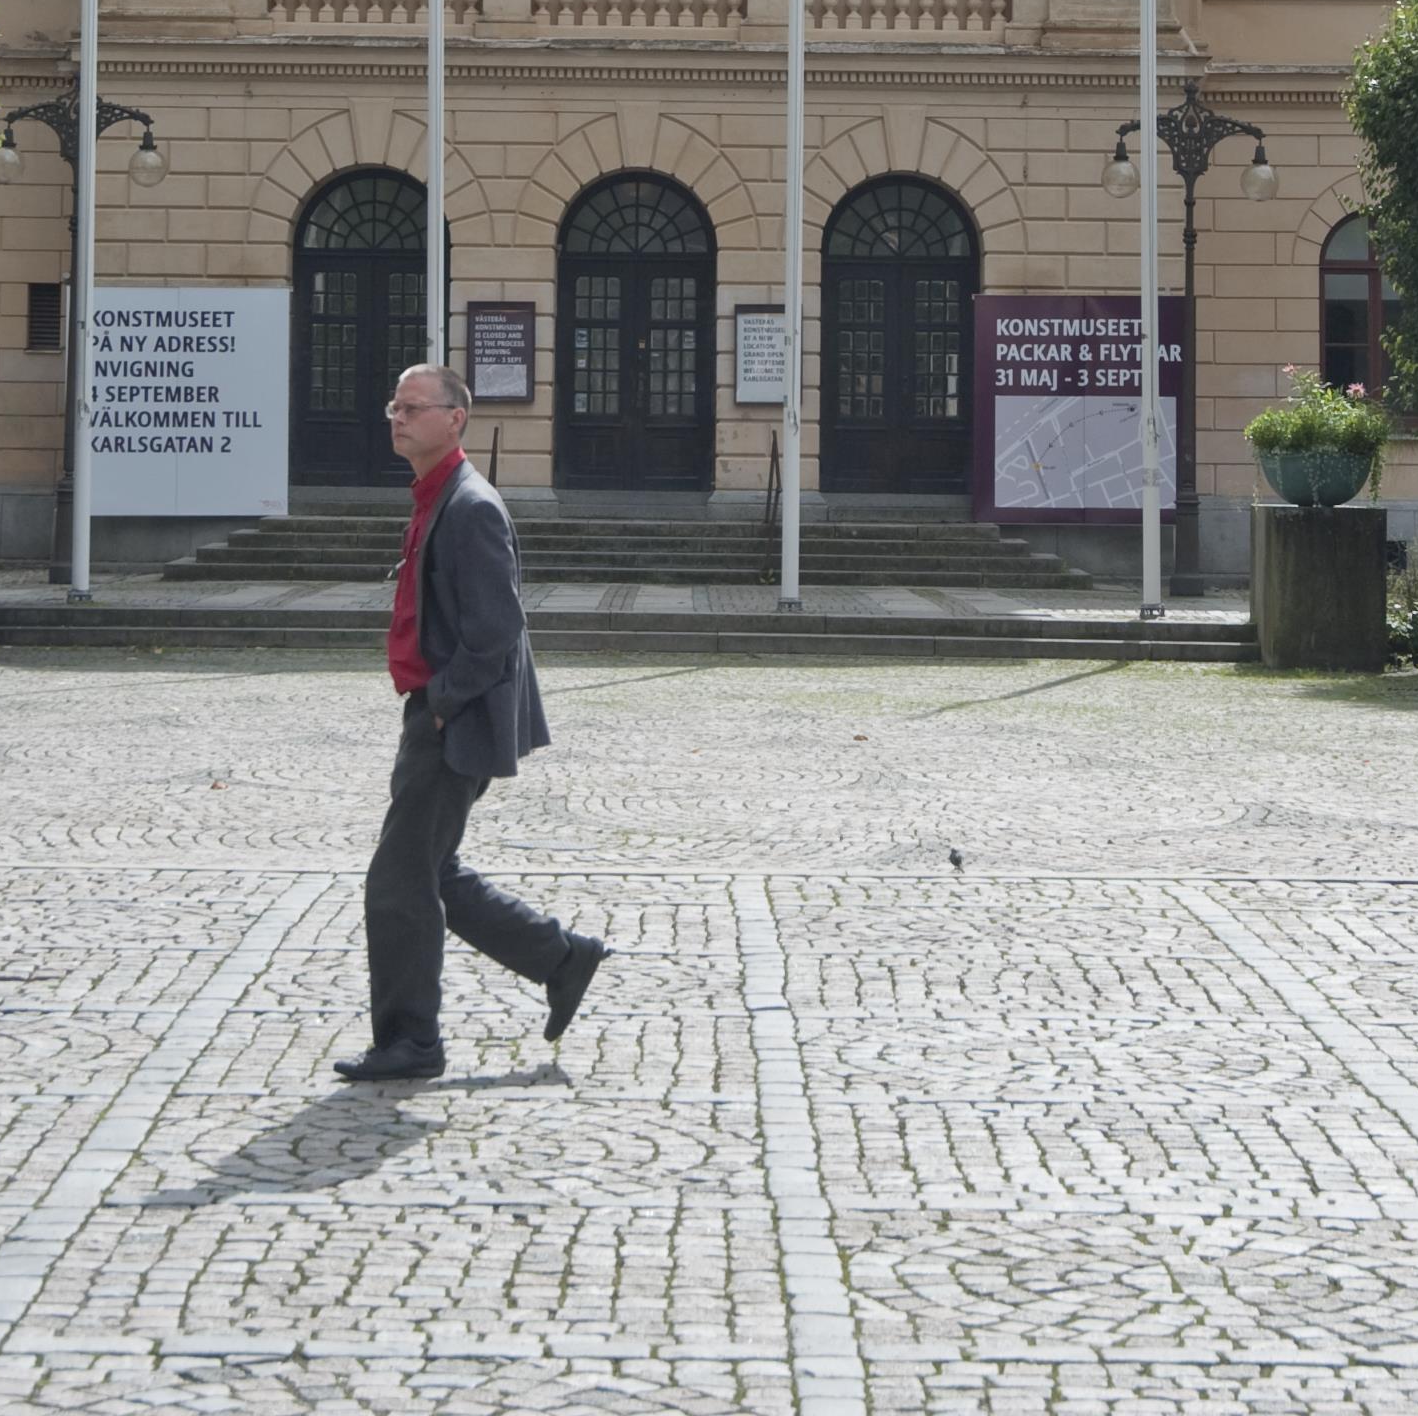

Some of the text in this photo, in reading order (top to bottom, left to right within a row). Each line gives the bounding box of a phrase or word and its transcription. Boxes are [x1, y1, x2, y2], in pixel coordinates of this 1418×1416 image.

[92, 310, 235, 328] KONSTMUSEET
[996, 318, 1143, 336] KONSTMUSEET
[120, 335, 148, 353] NY
[153, 335, 236, 353] ADRESS!
[996, 344, 1183, 362] PACKAR & FLYTAR
[94, 360, 195, 378] NVIGNING
[995, 368, 1014, 386] 31
[1020, 368, 1058, 391] MAJ
[1077, 368, 1089, 386] 3
[1095, 368, 1143, 386] SEPT
[105, 385, 220, 403] SEPTEMBER
[222, 411, 262, 428] TILL
[91, 435, 232, 453] KARLSGATAN 2
